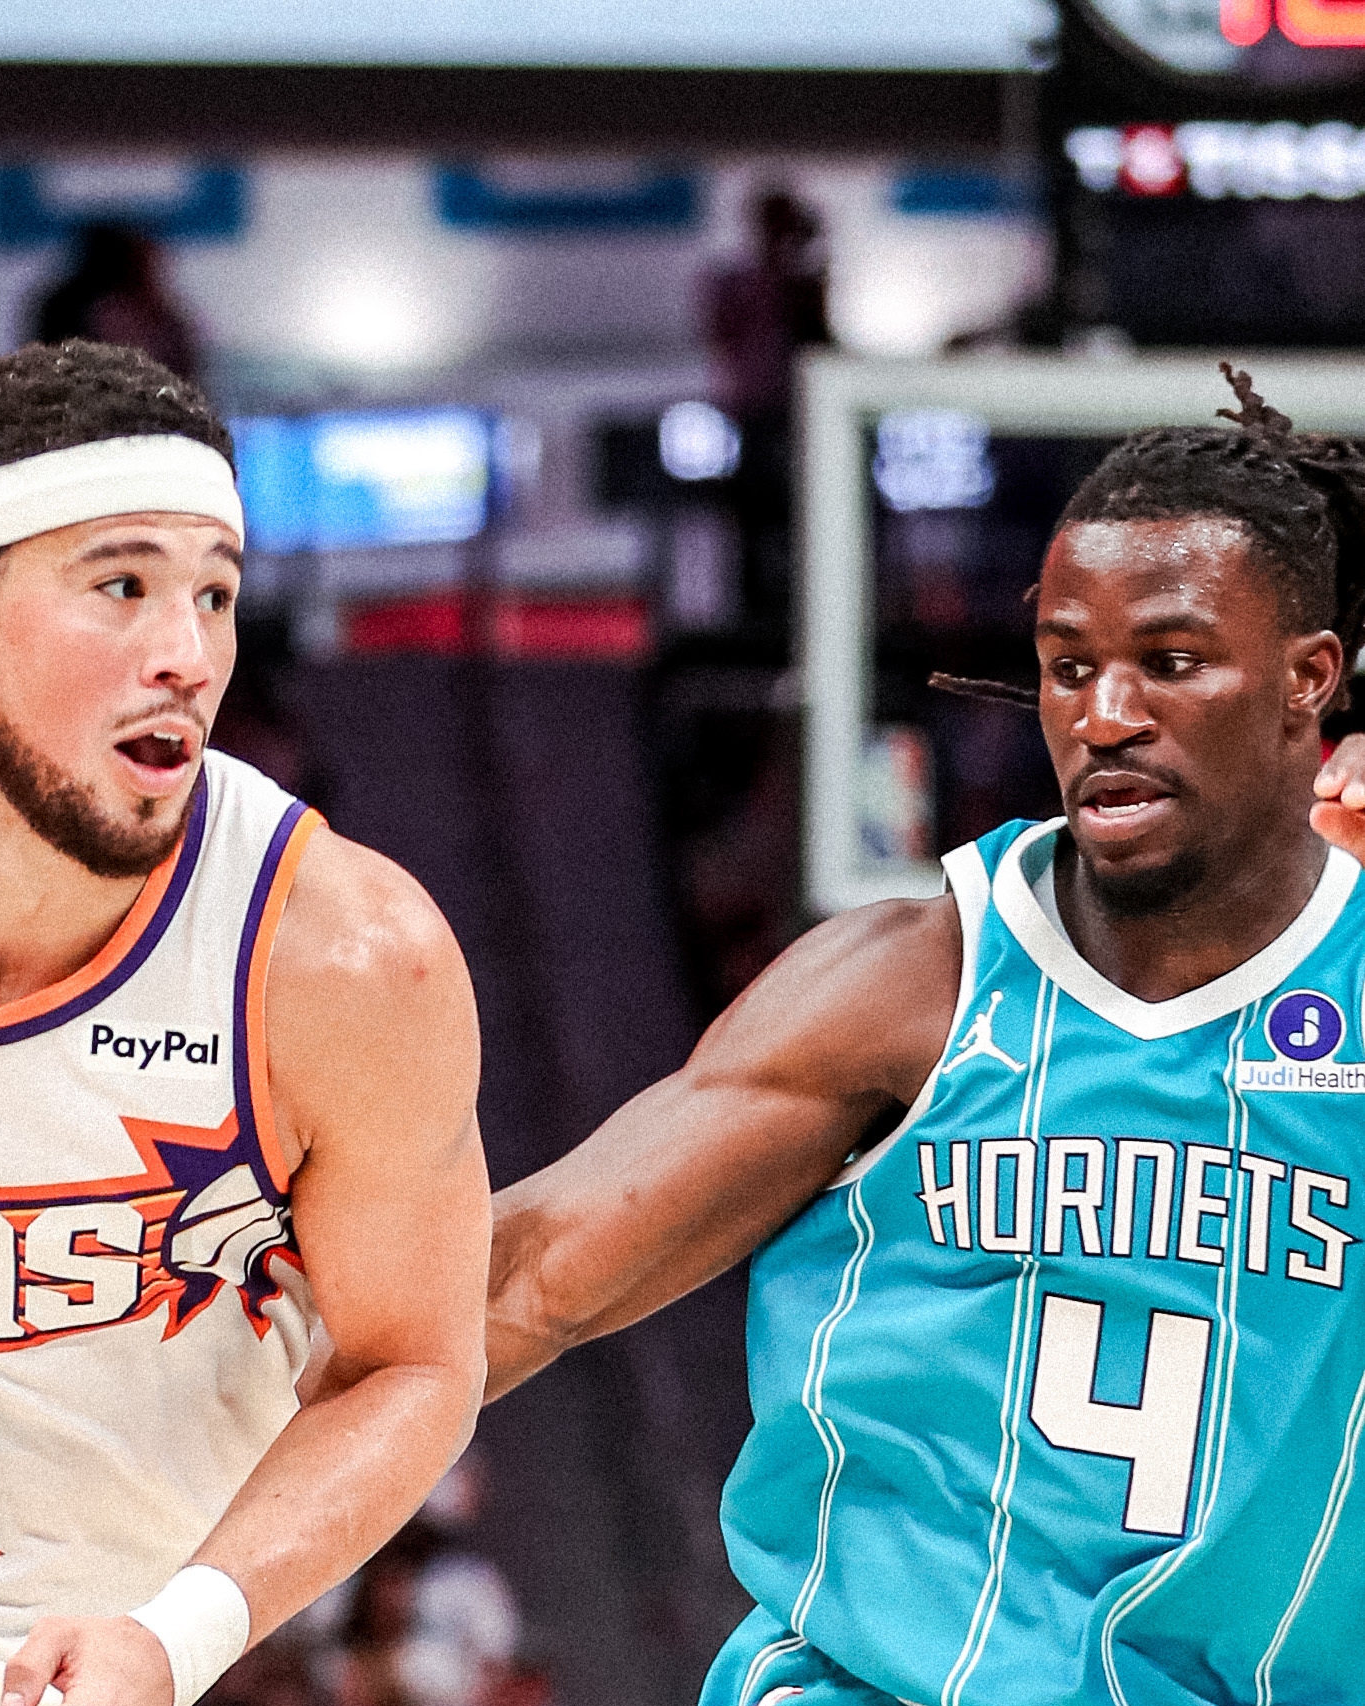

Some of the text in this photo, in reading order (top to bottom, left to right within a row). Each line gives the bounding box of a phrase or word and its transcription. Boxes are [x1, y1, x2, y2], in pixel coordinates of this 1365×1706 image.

[1173, 119, 1365, 200] TISS
[90, 1024, 220, 1069] PayPal
[1241, 1065, 1365, 1089] Judi Health
[915, 1136, 1363, 1290] HORNETS
[1029, 1291, 1214, 1538] 4
